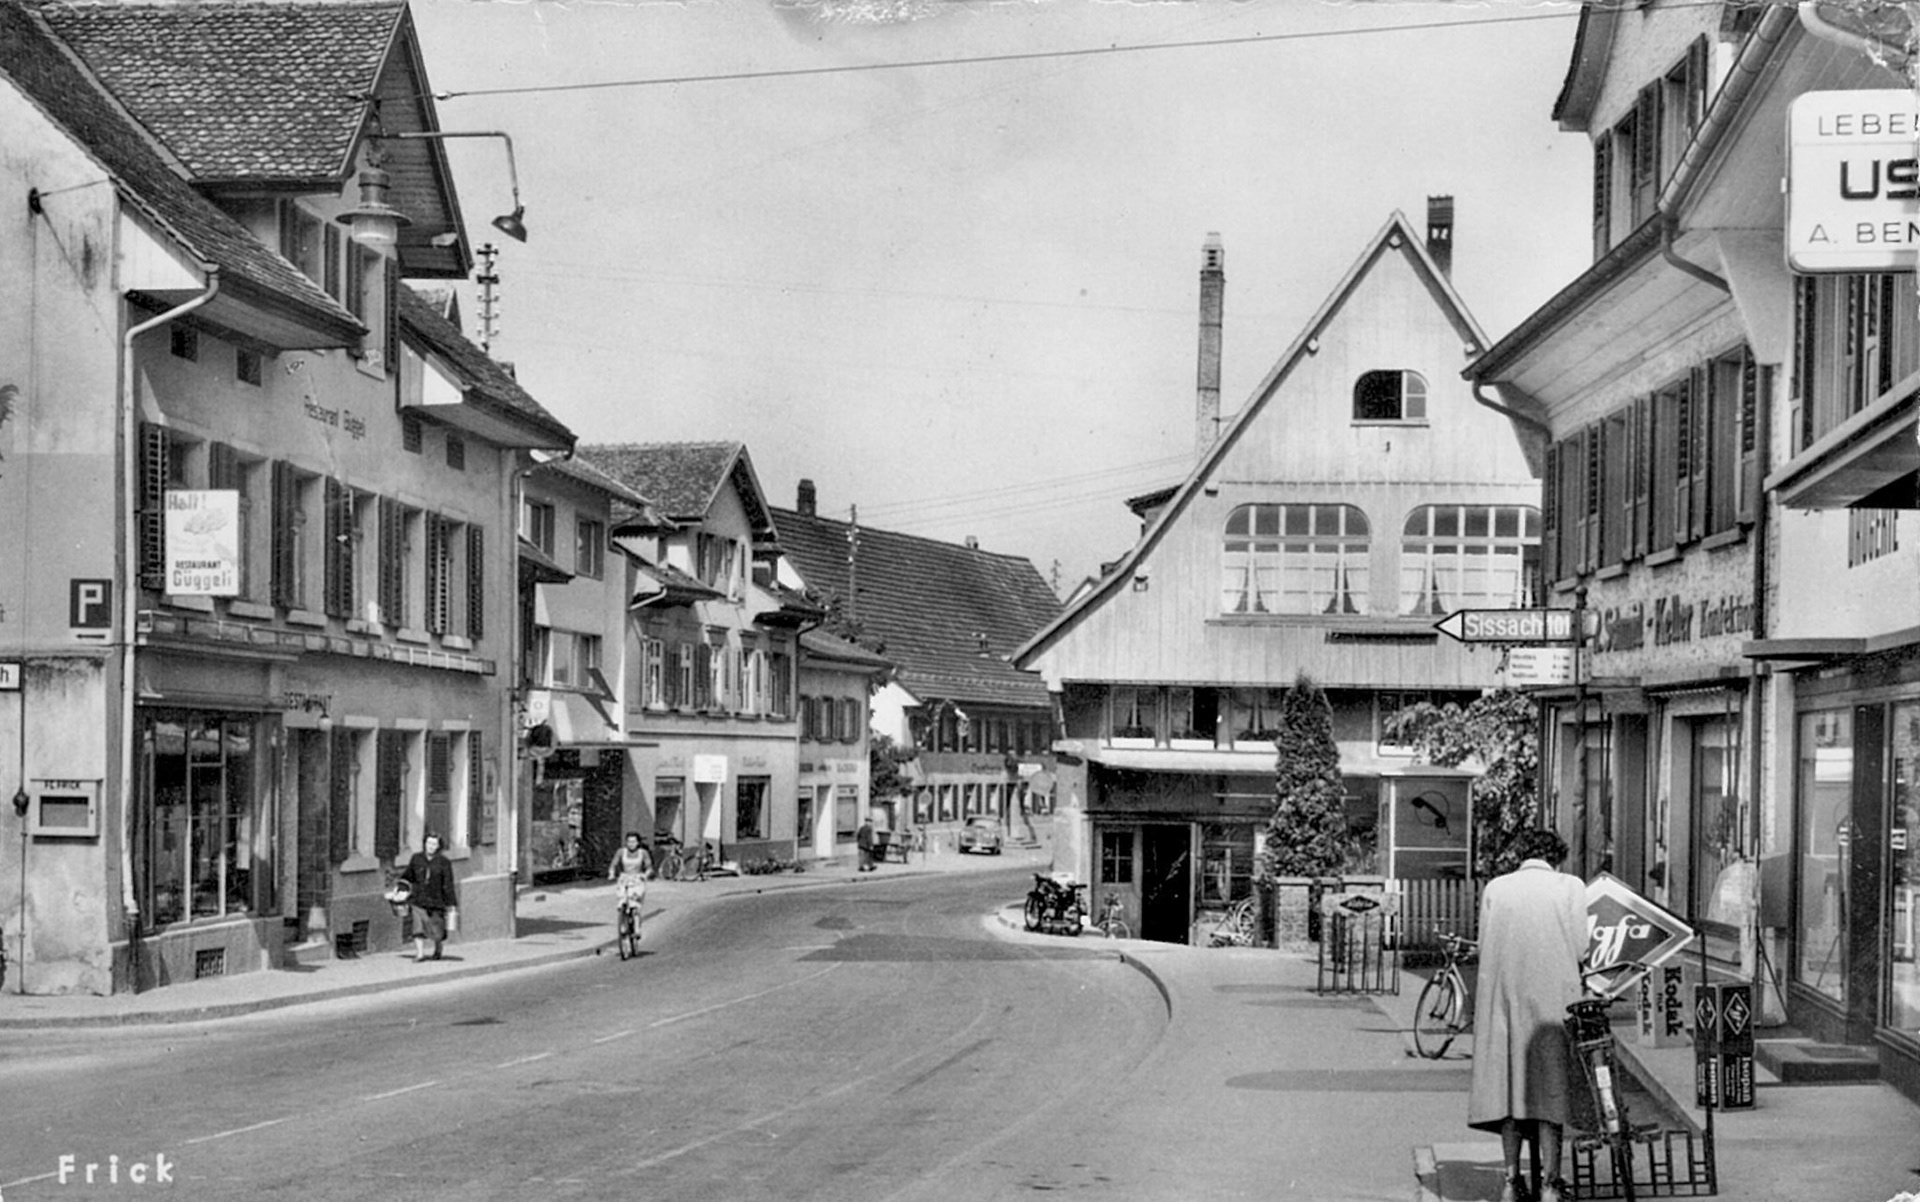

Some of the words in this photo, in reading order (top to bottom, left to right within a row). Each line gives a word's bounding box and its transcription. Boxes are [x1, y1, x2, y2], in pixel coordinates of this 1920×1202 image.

[1809, 223, 1839, 244] A.
[172, 569, 232, 591] Güggeli
[78, 583, 103, 624] P
[1464, 612, 1545, 637] Sissach
[1664, 965, 1684, 1037] Kodak
[1740, 1056, 1752, 1103] Isopan
